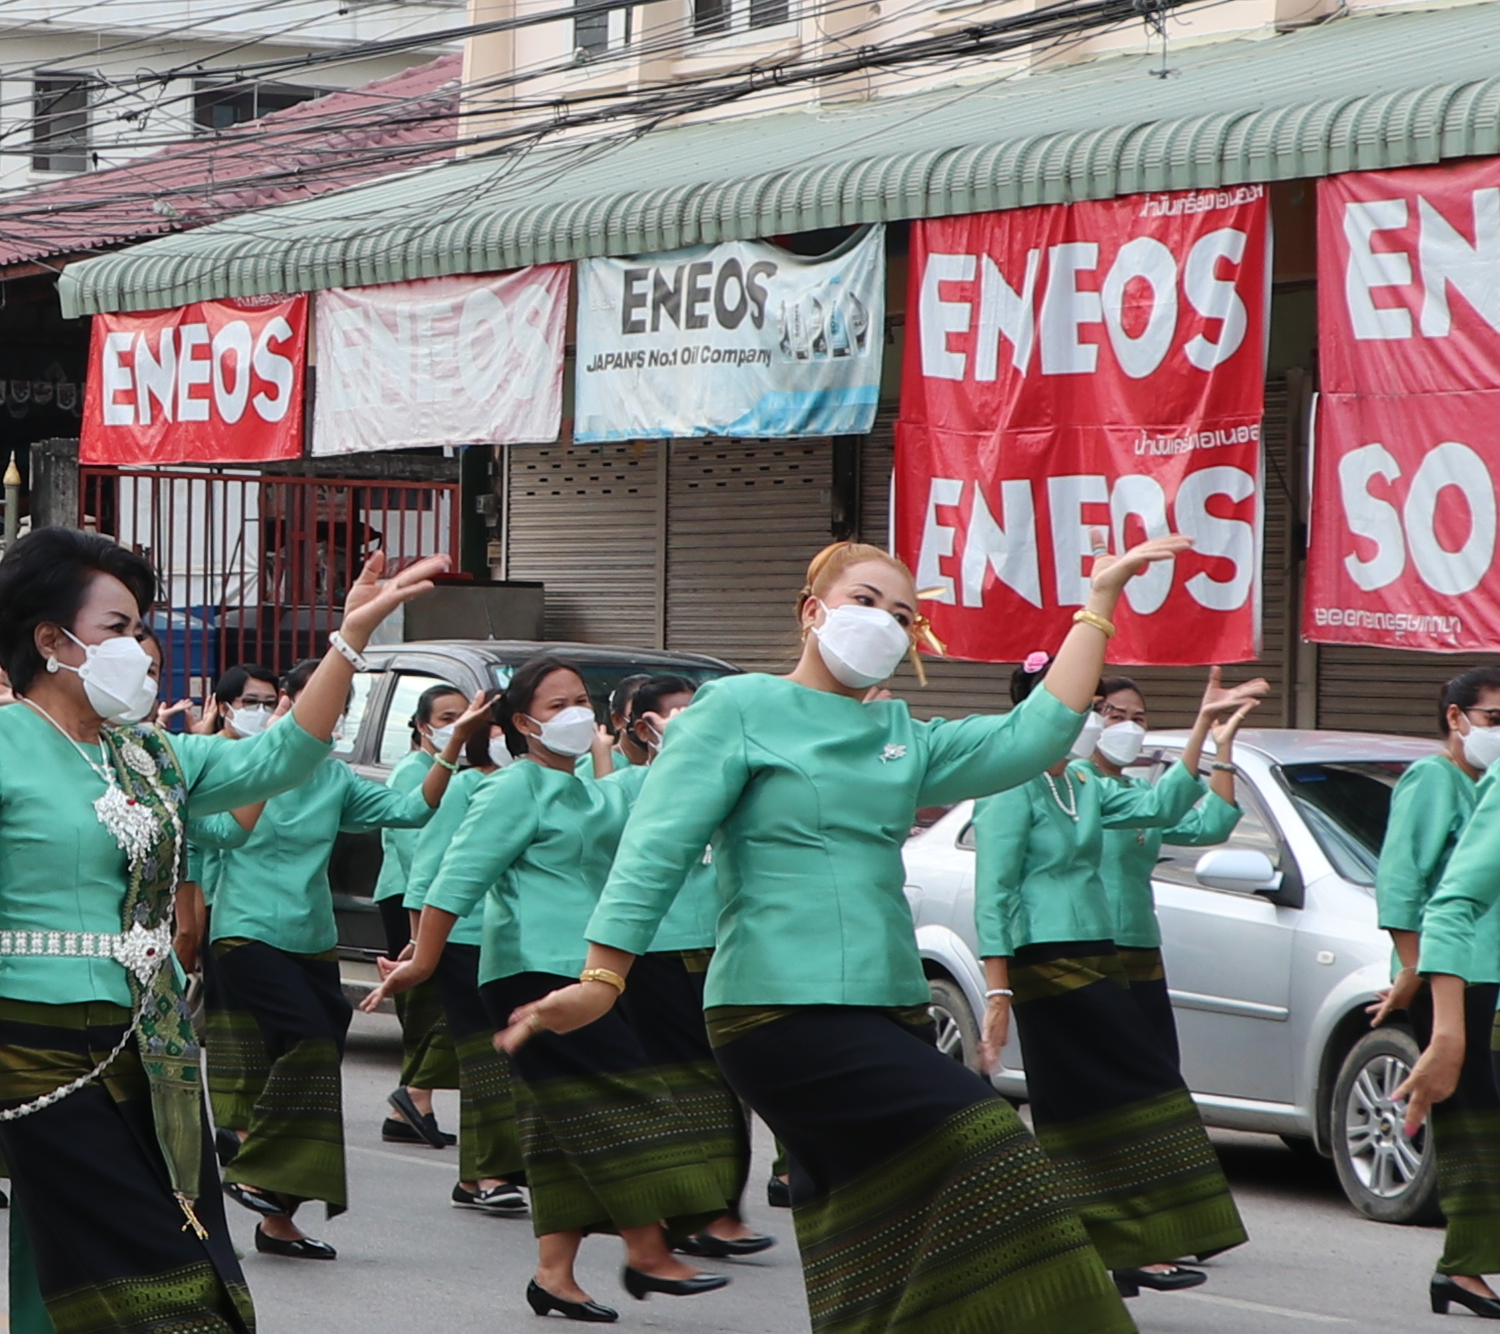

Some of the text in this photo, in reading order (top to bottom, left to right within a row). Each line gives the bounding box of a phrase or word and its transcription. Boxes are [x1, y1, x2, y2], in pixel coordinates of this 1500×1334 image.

[330, 283, 552, 412] ENEOS
[622, 257, 778, 335] ENEOS
[920, 227, 1248, 381] ENEOS
[102, 315, 294, 425] ENEOS
[586, 345, 772, 373] JAPAN'S No.1 Oil Company
[915, 465, 1256, 615] ENEOS
